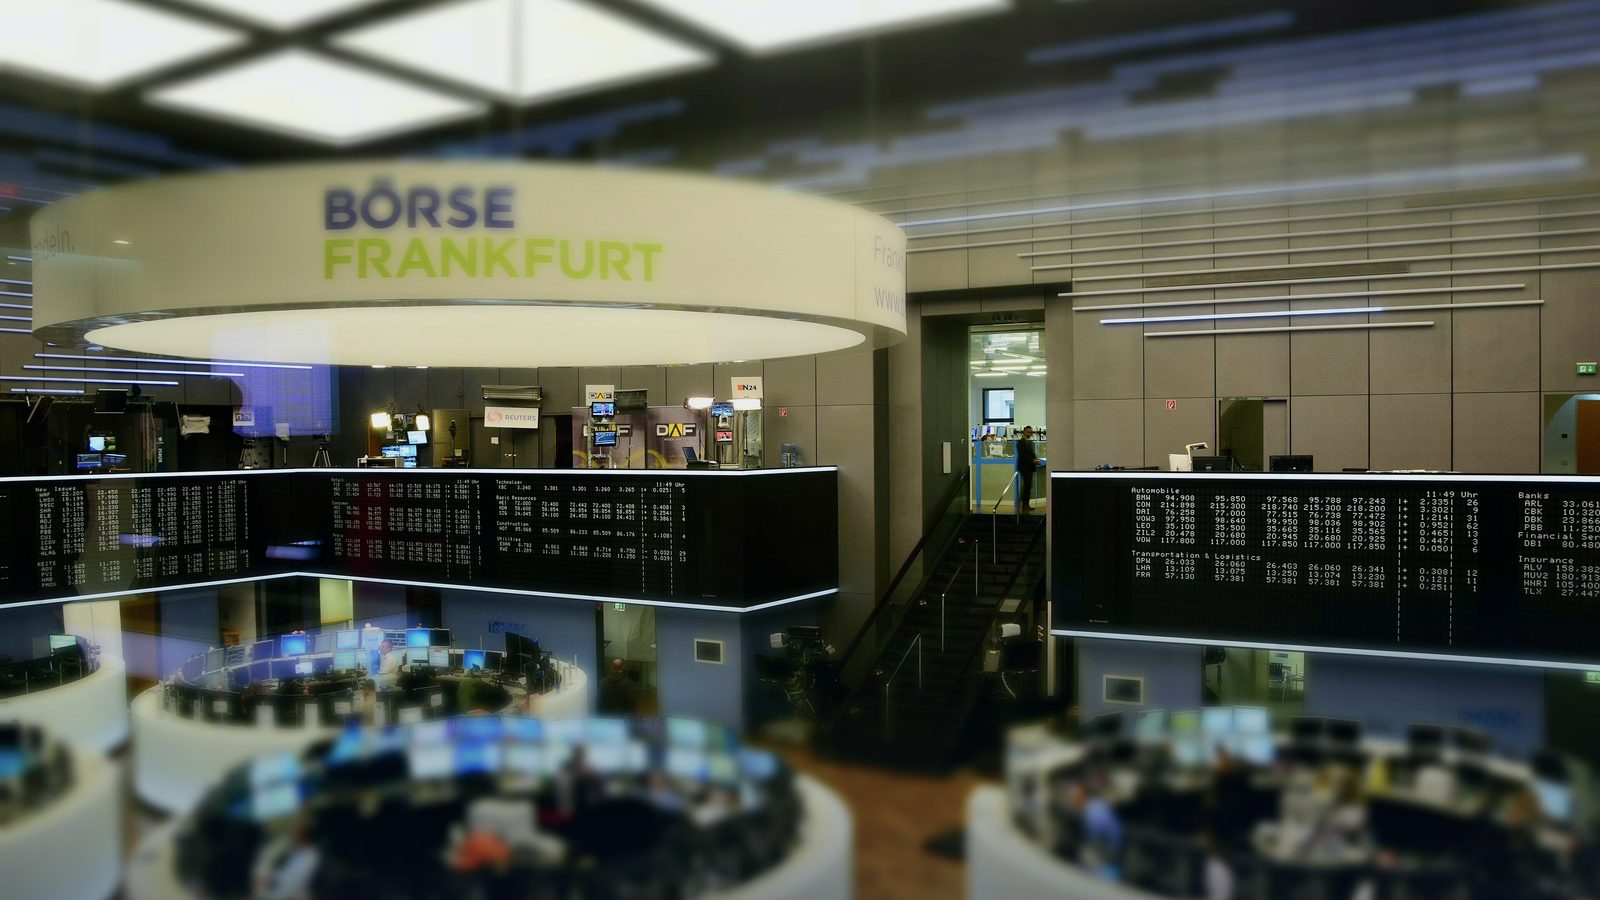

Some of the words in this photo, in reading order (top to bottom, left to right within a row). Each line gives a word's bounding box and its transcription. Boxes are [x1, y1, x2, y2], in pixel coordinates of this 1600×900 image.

[322, 178, 516, 231] BÖRSE
[322, 236, 664, 282] FRANKFURT
[504, 414, 537, 422] REUTERS
[655, 422, 696, 437] DAF
[1519, 492, 1550, 500] Banks
[1518, 532, 1574, 540] Financial
[1132, 550, 1200, 558] Transportation
[1215, 553, 1261, 561] Logistics
[1519, 556, 1574, 564] Insurance
